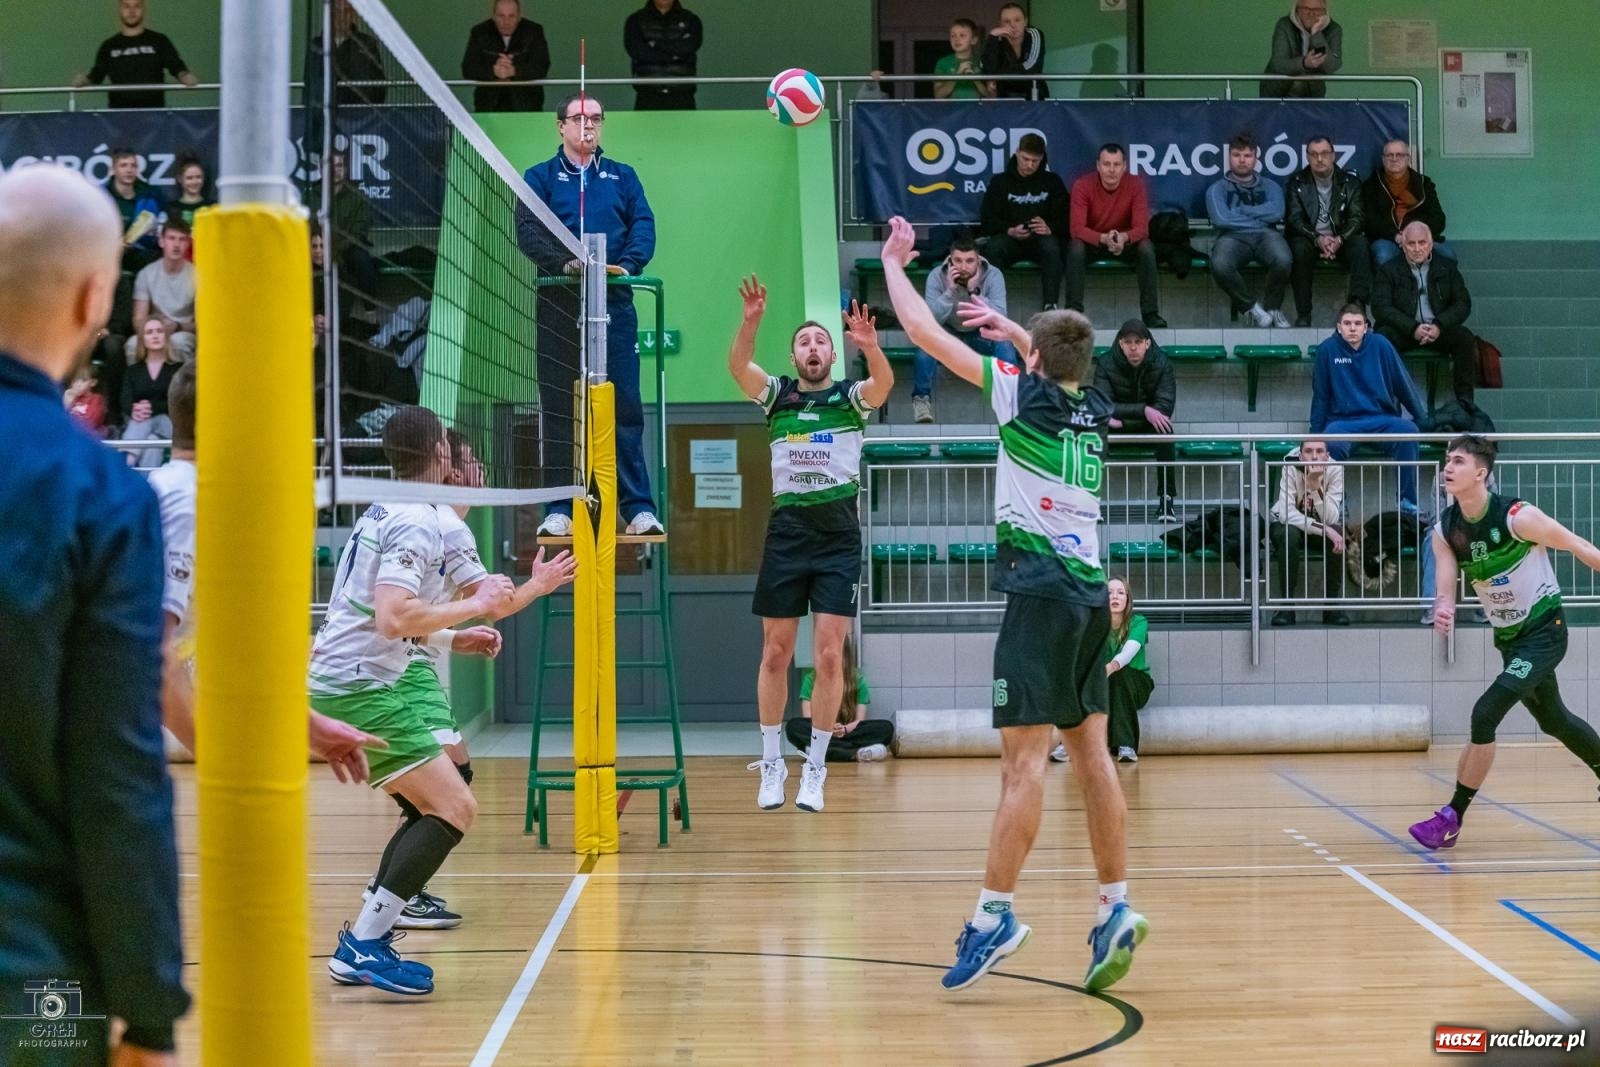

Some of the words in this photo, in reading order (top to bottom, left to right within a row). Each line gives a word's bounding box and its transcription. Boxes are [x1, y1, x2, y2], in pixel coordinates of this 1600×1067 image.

[789, 450, 831, 460] PIVEXIN
[1058, 428, 1104, 493] 16
[1470, 541, 1489, 562] 23
[1504, 657, 1533, 679] 23
